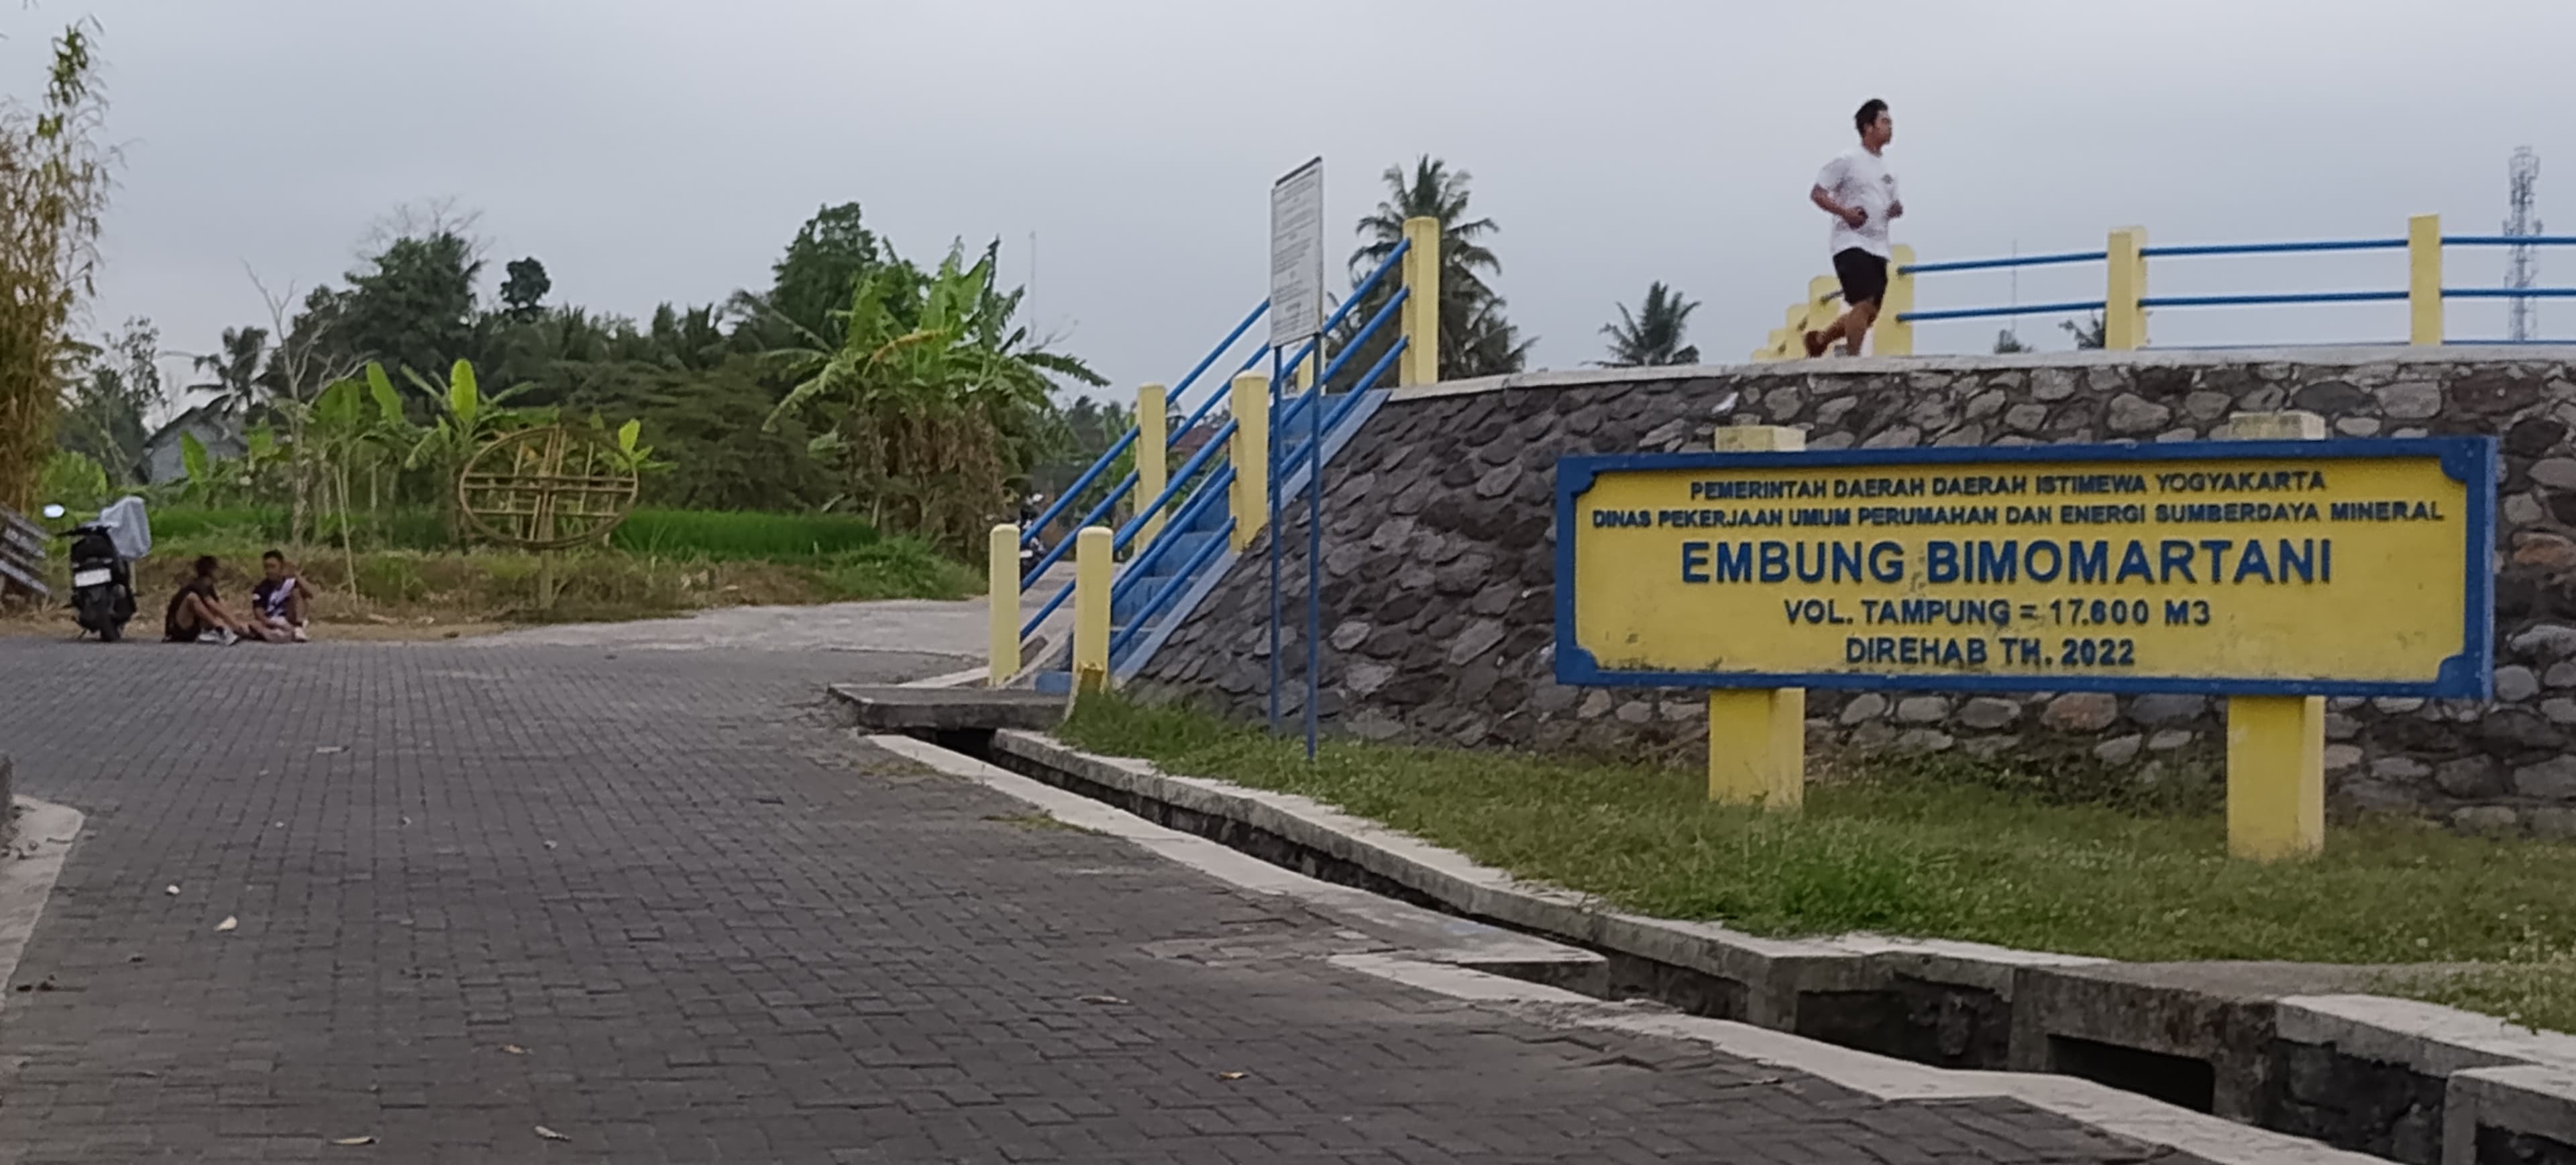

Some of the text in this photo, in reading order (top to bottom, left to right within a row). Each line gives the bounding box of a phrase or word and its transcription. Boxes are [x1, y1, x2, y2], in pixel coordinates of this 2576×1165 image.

[1690, 471, 2326, 501] PEMERINTAH DAERAH DAERAH ISTIMEWA YOGYAKARTA
[1592, 500, 2444, 529] DINAS PEKERJAAN UMUM PERUMAHAN DAN ENERGI SUMBERDAYA MINERAL
[1682, 539, 2331, 585] EMBUNG BIMOMARTANI
[1784, 598, 2210, 626] VOL. TAMPUNG = 17.600 M3
[1845, 636, 2135, 666] DIREHAB TH. 2022
